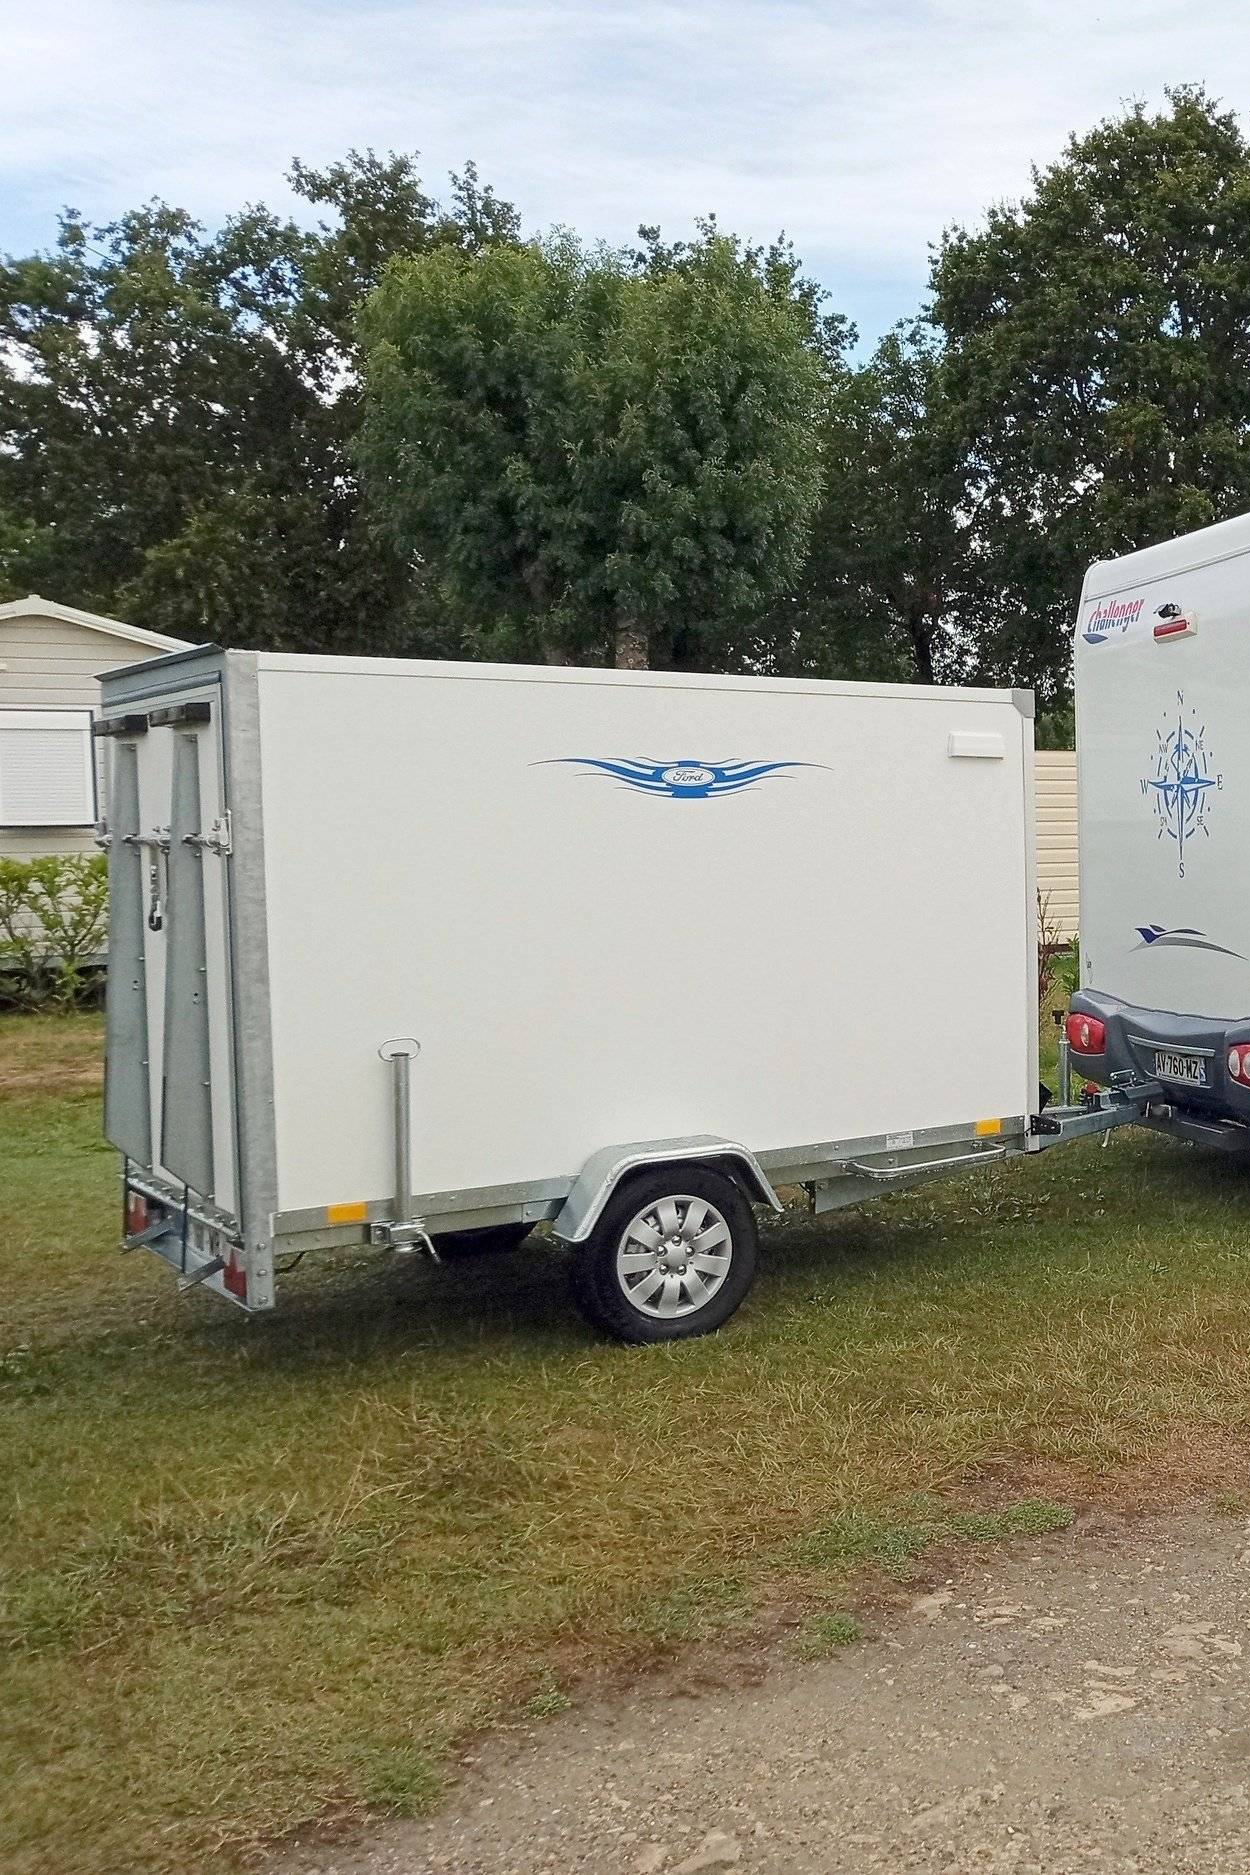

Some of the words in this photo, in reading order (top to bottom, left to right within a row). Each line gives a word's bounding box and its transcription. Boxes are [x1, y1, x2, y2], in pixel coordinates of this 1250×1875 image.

[1177, 690, 1184, 706] N
[1195, 739, 1204, 751] NE
[672, 769, 704, 782] Ford
[1217, 774, 1223, 790] E
[1140, 778, 1149, 796] W
[1196, 815, 1204, 826] SE
[1179, 863, 1185, 878] S
